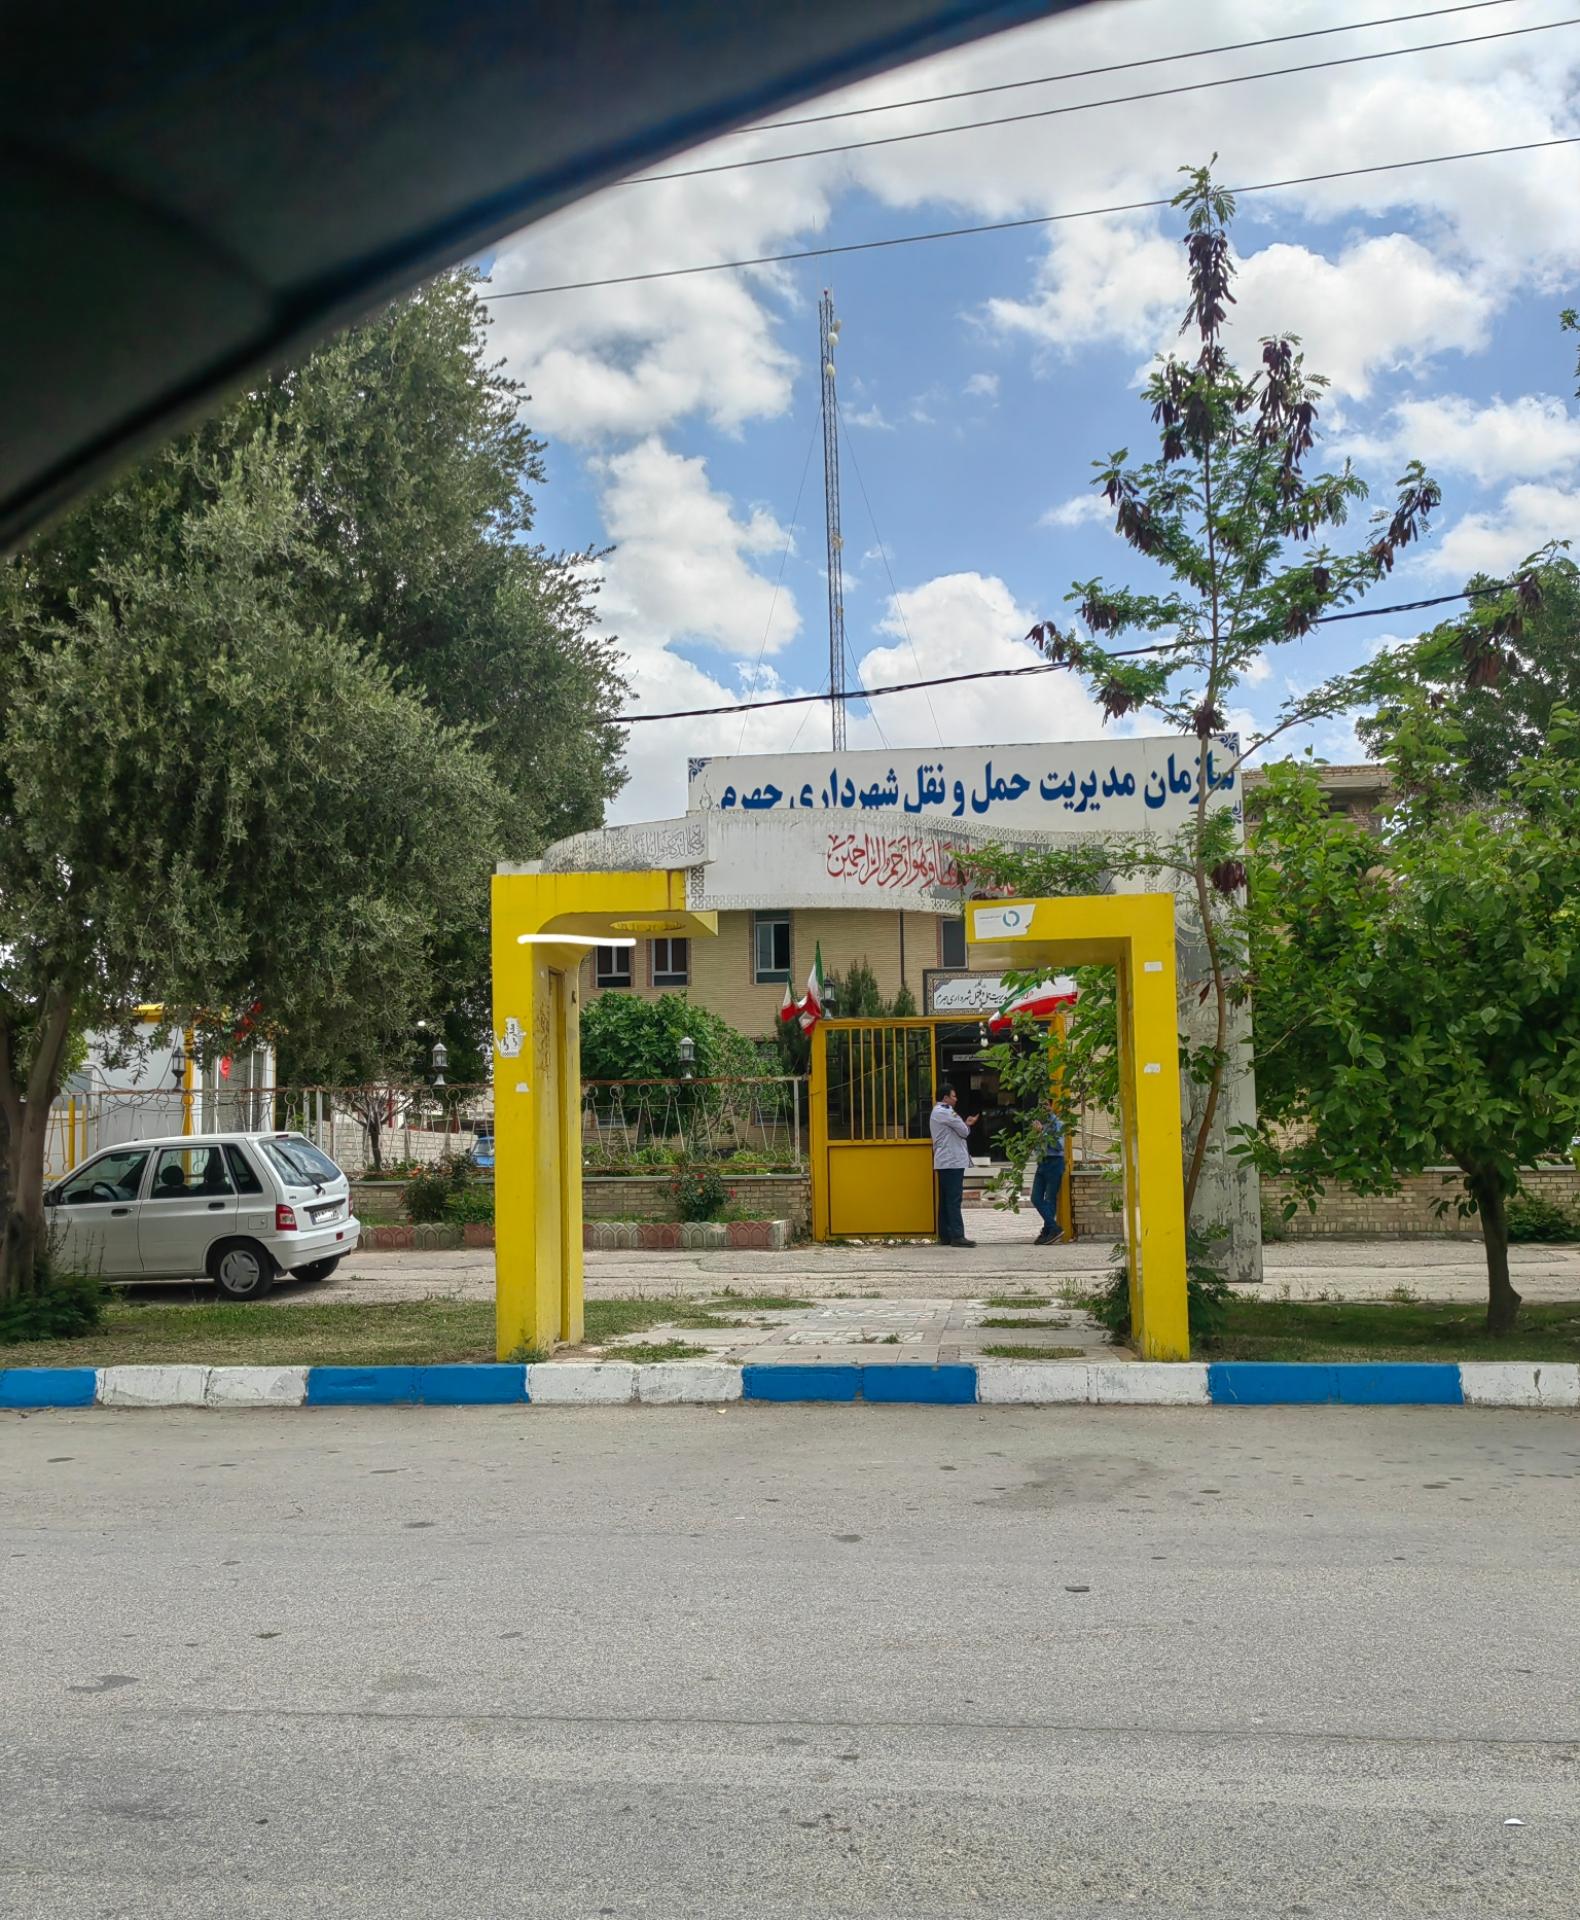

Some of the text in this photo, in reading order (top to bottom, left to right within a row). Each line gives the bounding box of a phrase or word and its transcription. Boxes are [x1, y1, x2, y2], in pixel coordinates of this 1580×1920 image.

[903, 762, 947, 814] نقل
[951, 779, 966, 817] و
[971, 760, 1031, 814] حمل
[1039, 765, 1135, 813] مدیریت
